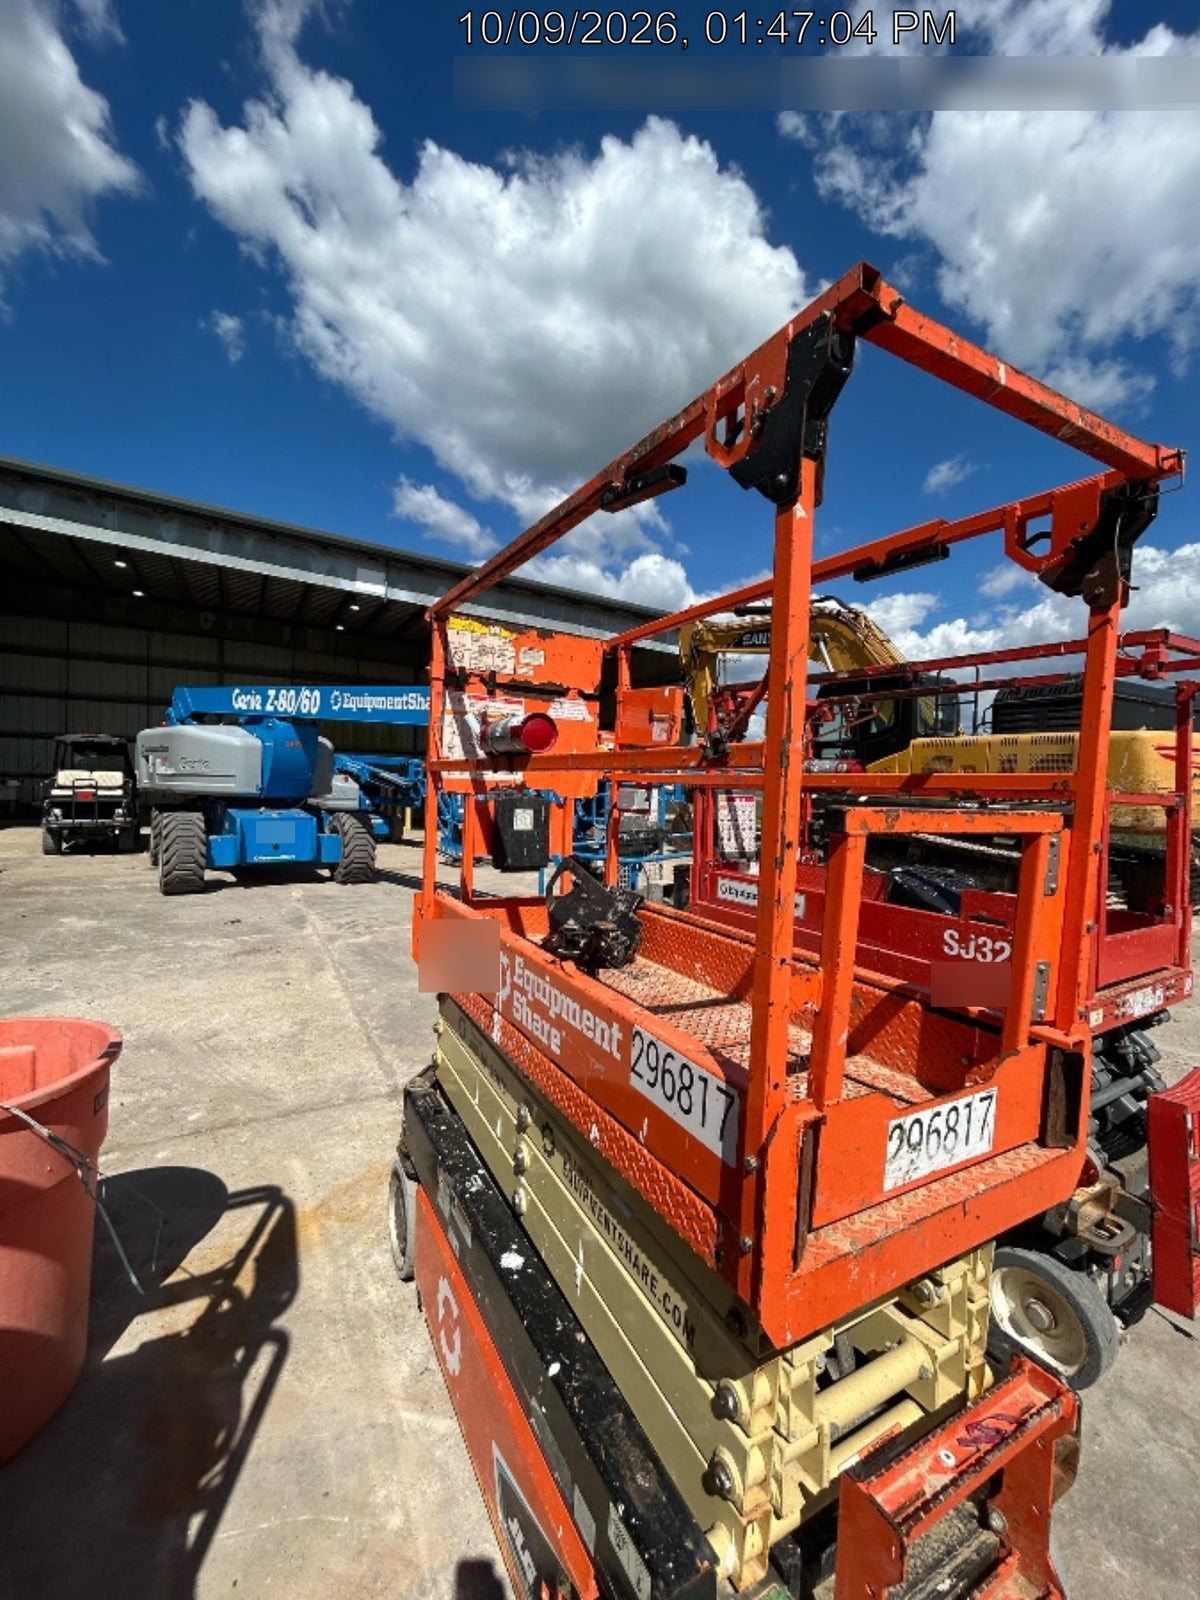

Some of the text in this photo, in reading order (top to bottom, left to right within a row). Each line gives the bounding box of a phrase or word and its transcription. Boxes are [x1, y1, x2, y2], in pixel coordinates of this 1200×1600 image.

[742, 631, 771, 646] SAN
[232, 687, 321, 715] Genie Z-80/60
[342, 693, 430, 712] EquipmentSha
[942, 929, 1012, 962] SJ32
[511, 990, 563, 1055] Share
[512, 954, 624, 1062] Equipment
[630, 1030, 736, 1142] 296817
[888, 1092, 995, 1161] 296817
[562, 1157, 696, 1348] EQUIPMENTSHARE.COM
